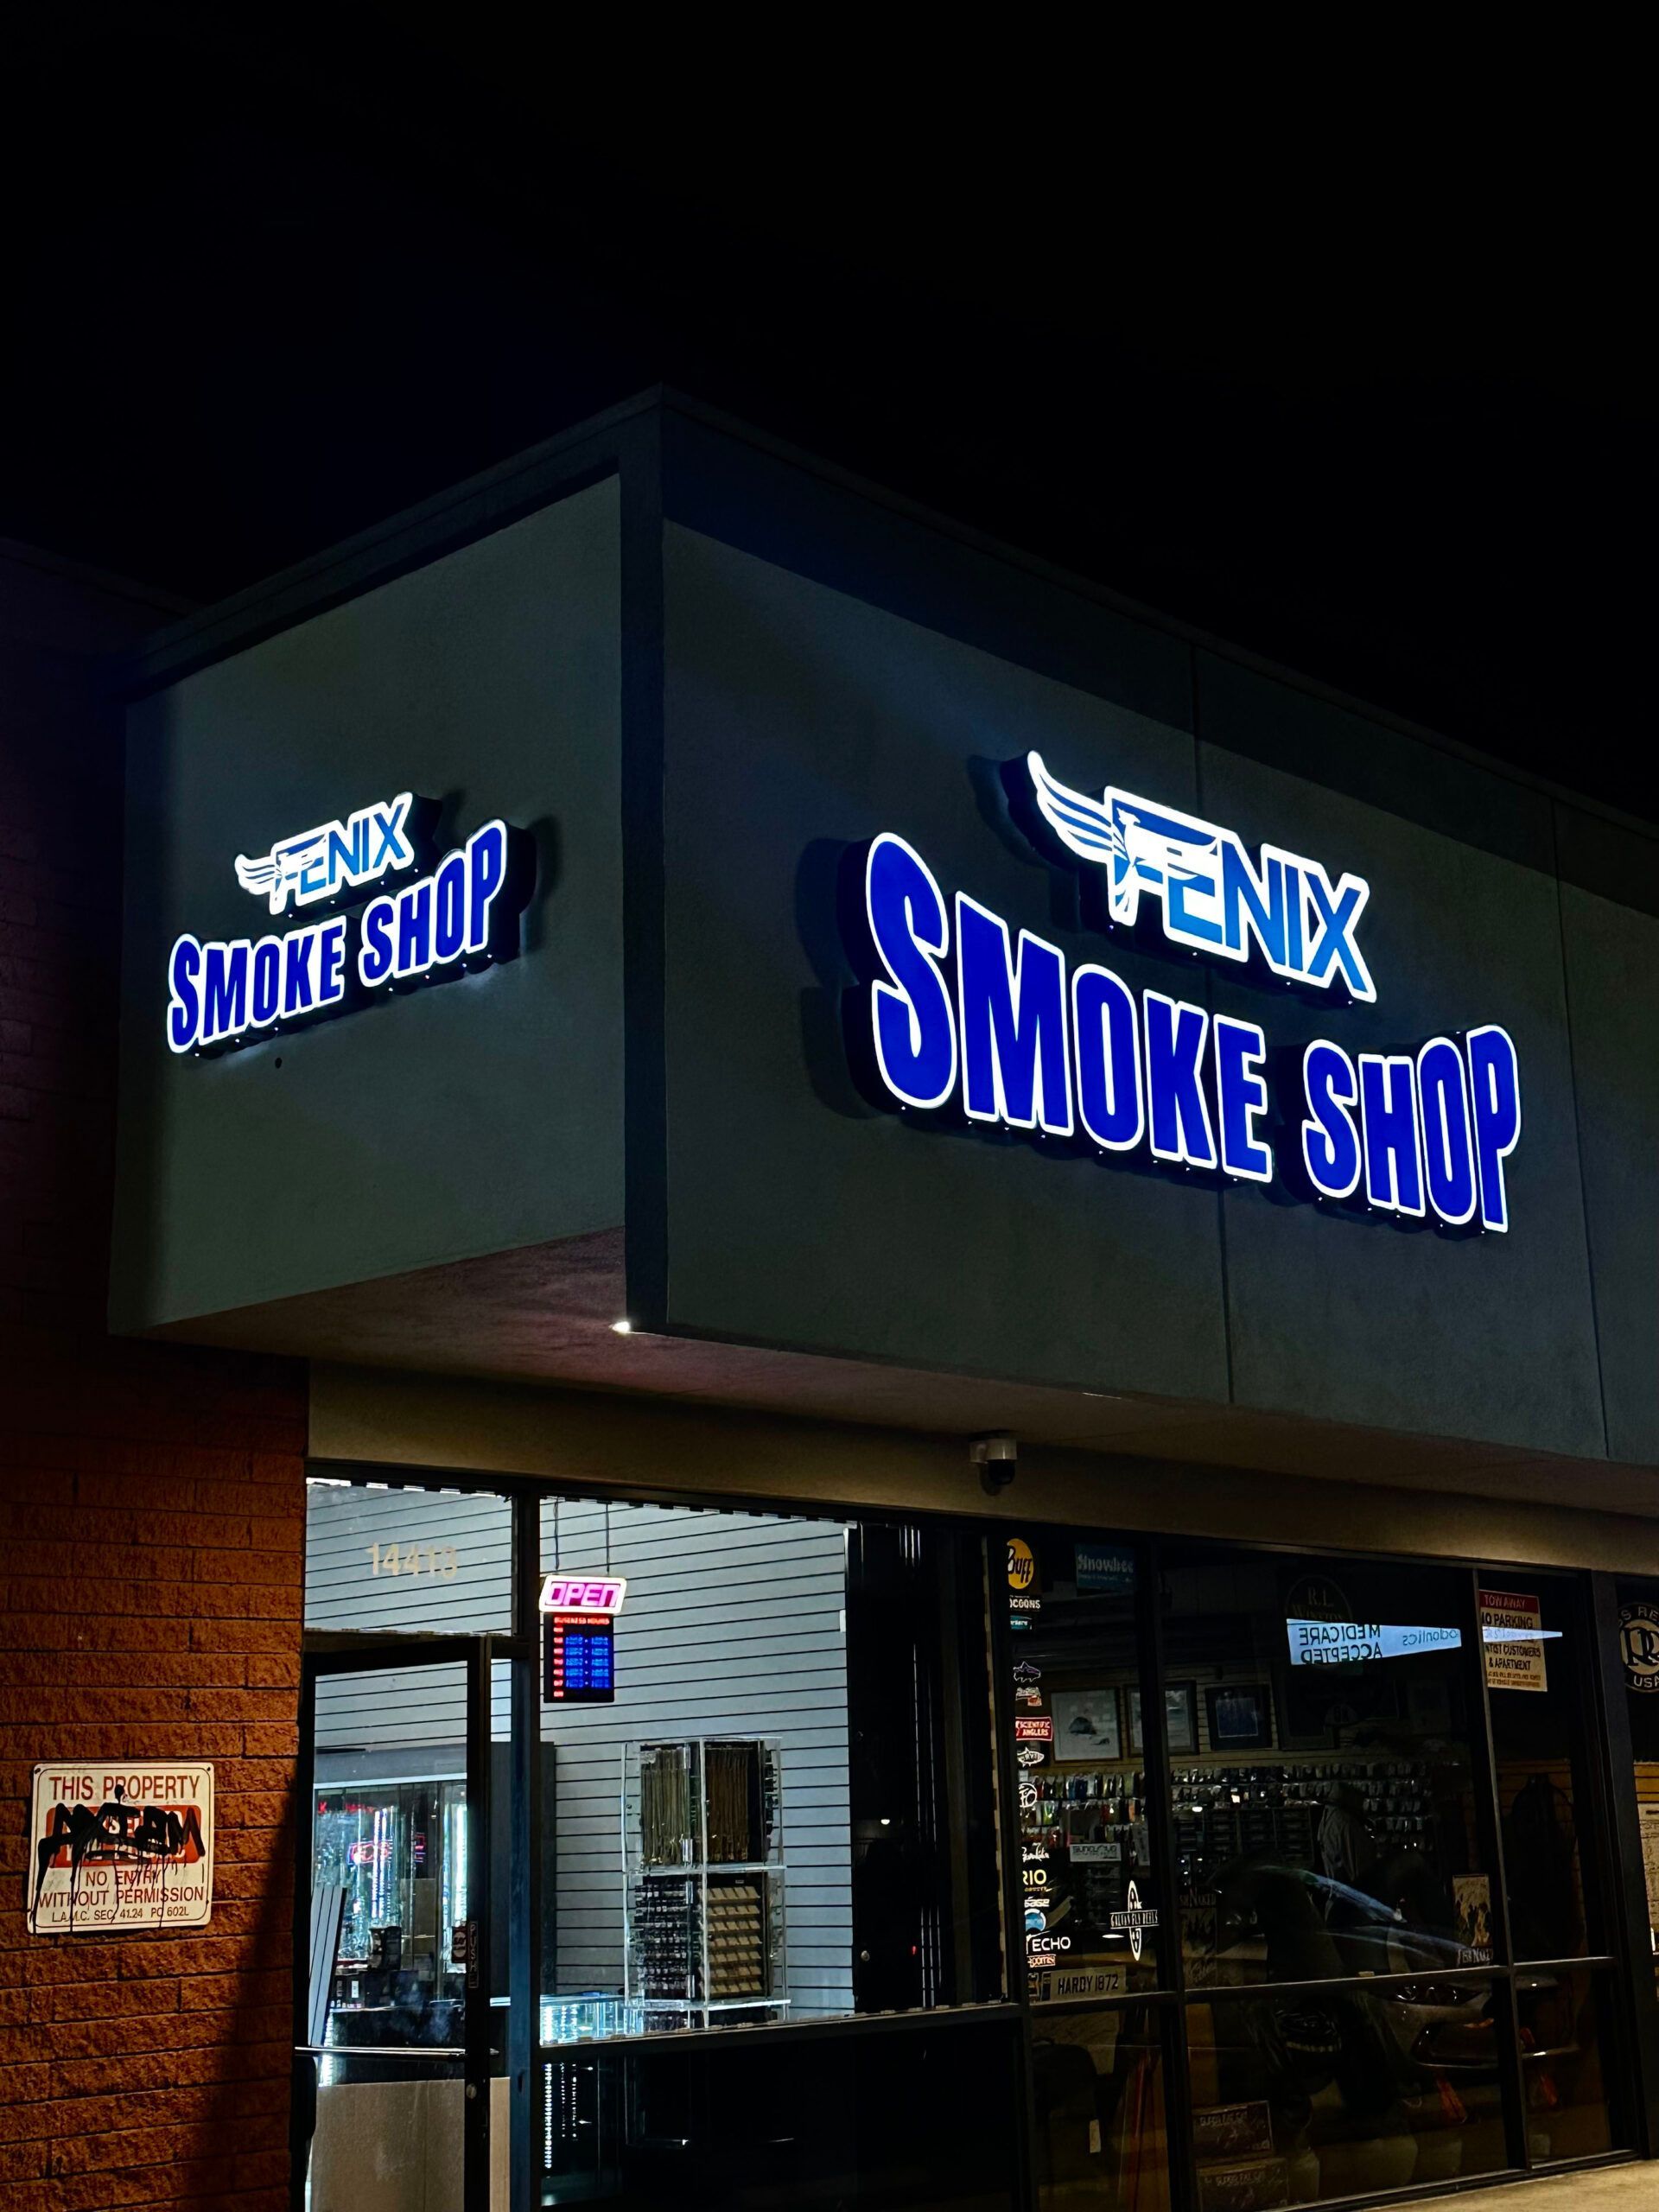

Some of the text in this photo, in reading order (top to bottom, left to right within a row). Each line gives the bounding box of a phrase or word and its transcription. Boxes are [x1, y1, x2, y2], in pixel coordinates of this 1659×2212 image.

[266, 792, 414, 915] FENIX
[1104, 785, 1377, 1002] FENIX
[168, 819, 507, 1053] SMOKE SHOP
[866, 832, 1522, 1233] SMOKE SHOP
[545, 1581, 621, 1607] OPEN
[1494, 1612, 1533, 1628] PARKING
[48, 1776, 94, 1801] THIS
[86, 1871, 108, 1887] NO
[40, 1886, 204, 1909] WITHOUT PERMISSION
[1032, 1936, 1071, 1953] ECHO
[1058, 1973, 1119, 1995] HARDY 1872
